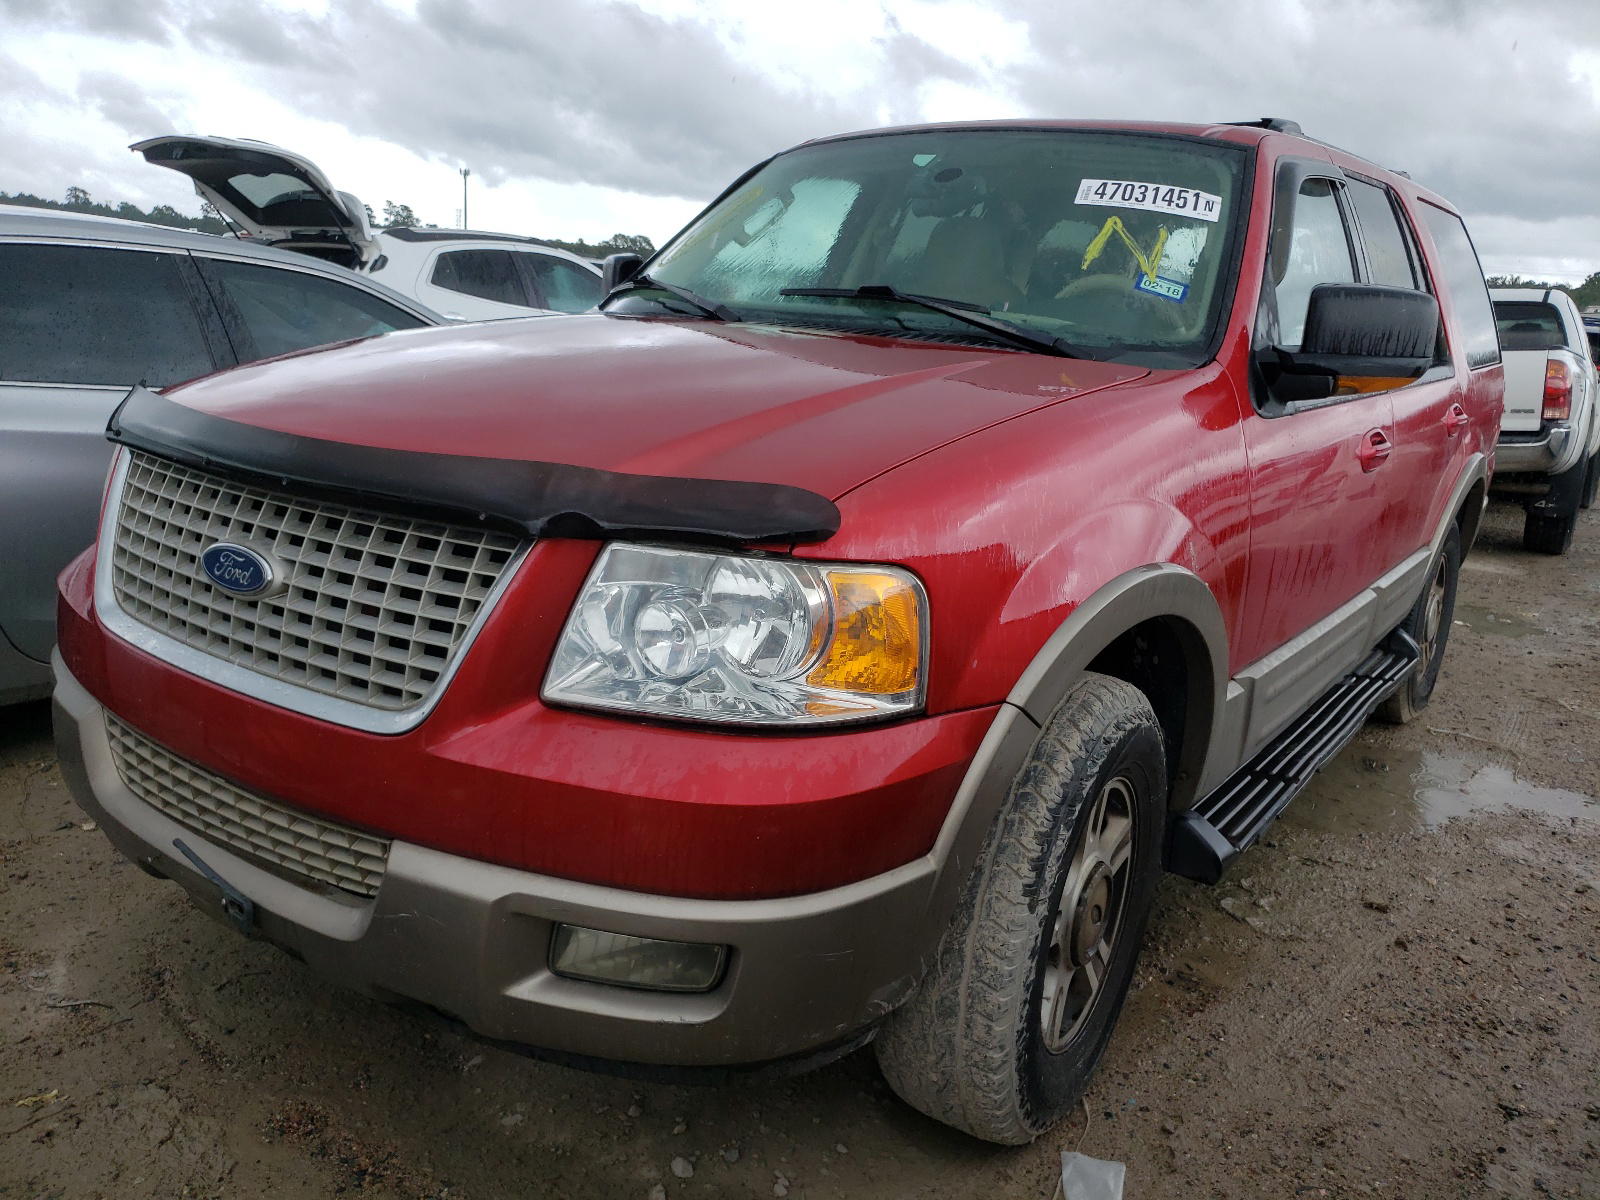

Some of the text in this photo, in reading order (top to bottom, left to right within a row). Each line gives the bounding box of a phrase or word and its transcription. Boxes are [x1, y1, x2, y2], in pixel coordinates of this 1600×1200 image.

[1094, 181, 1201, 212] 47031451
[1204, 200, 1215, 213] N
[214, 551, 253, 585] Ford
